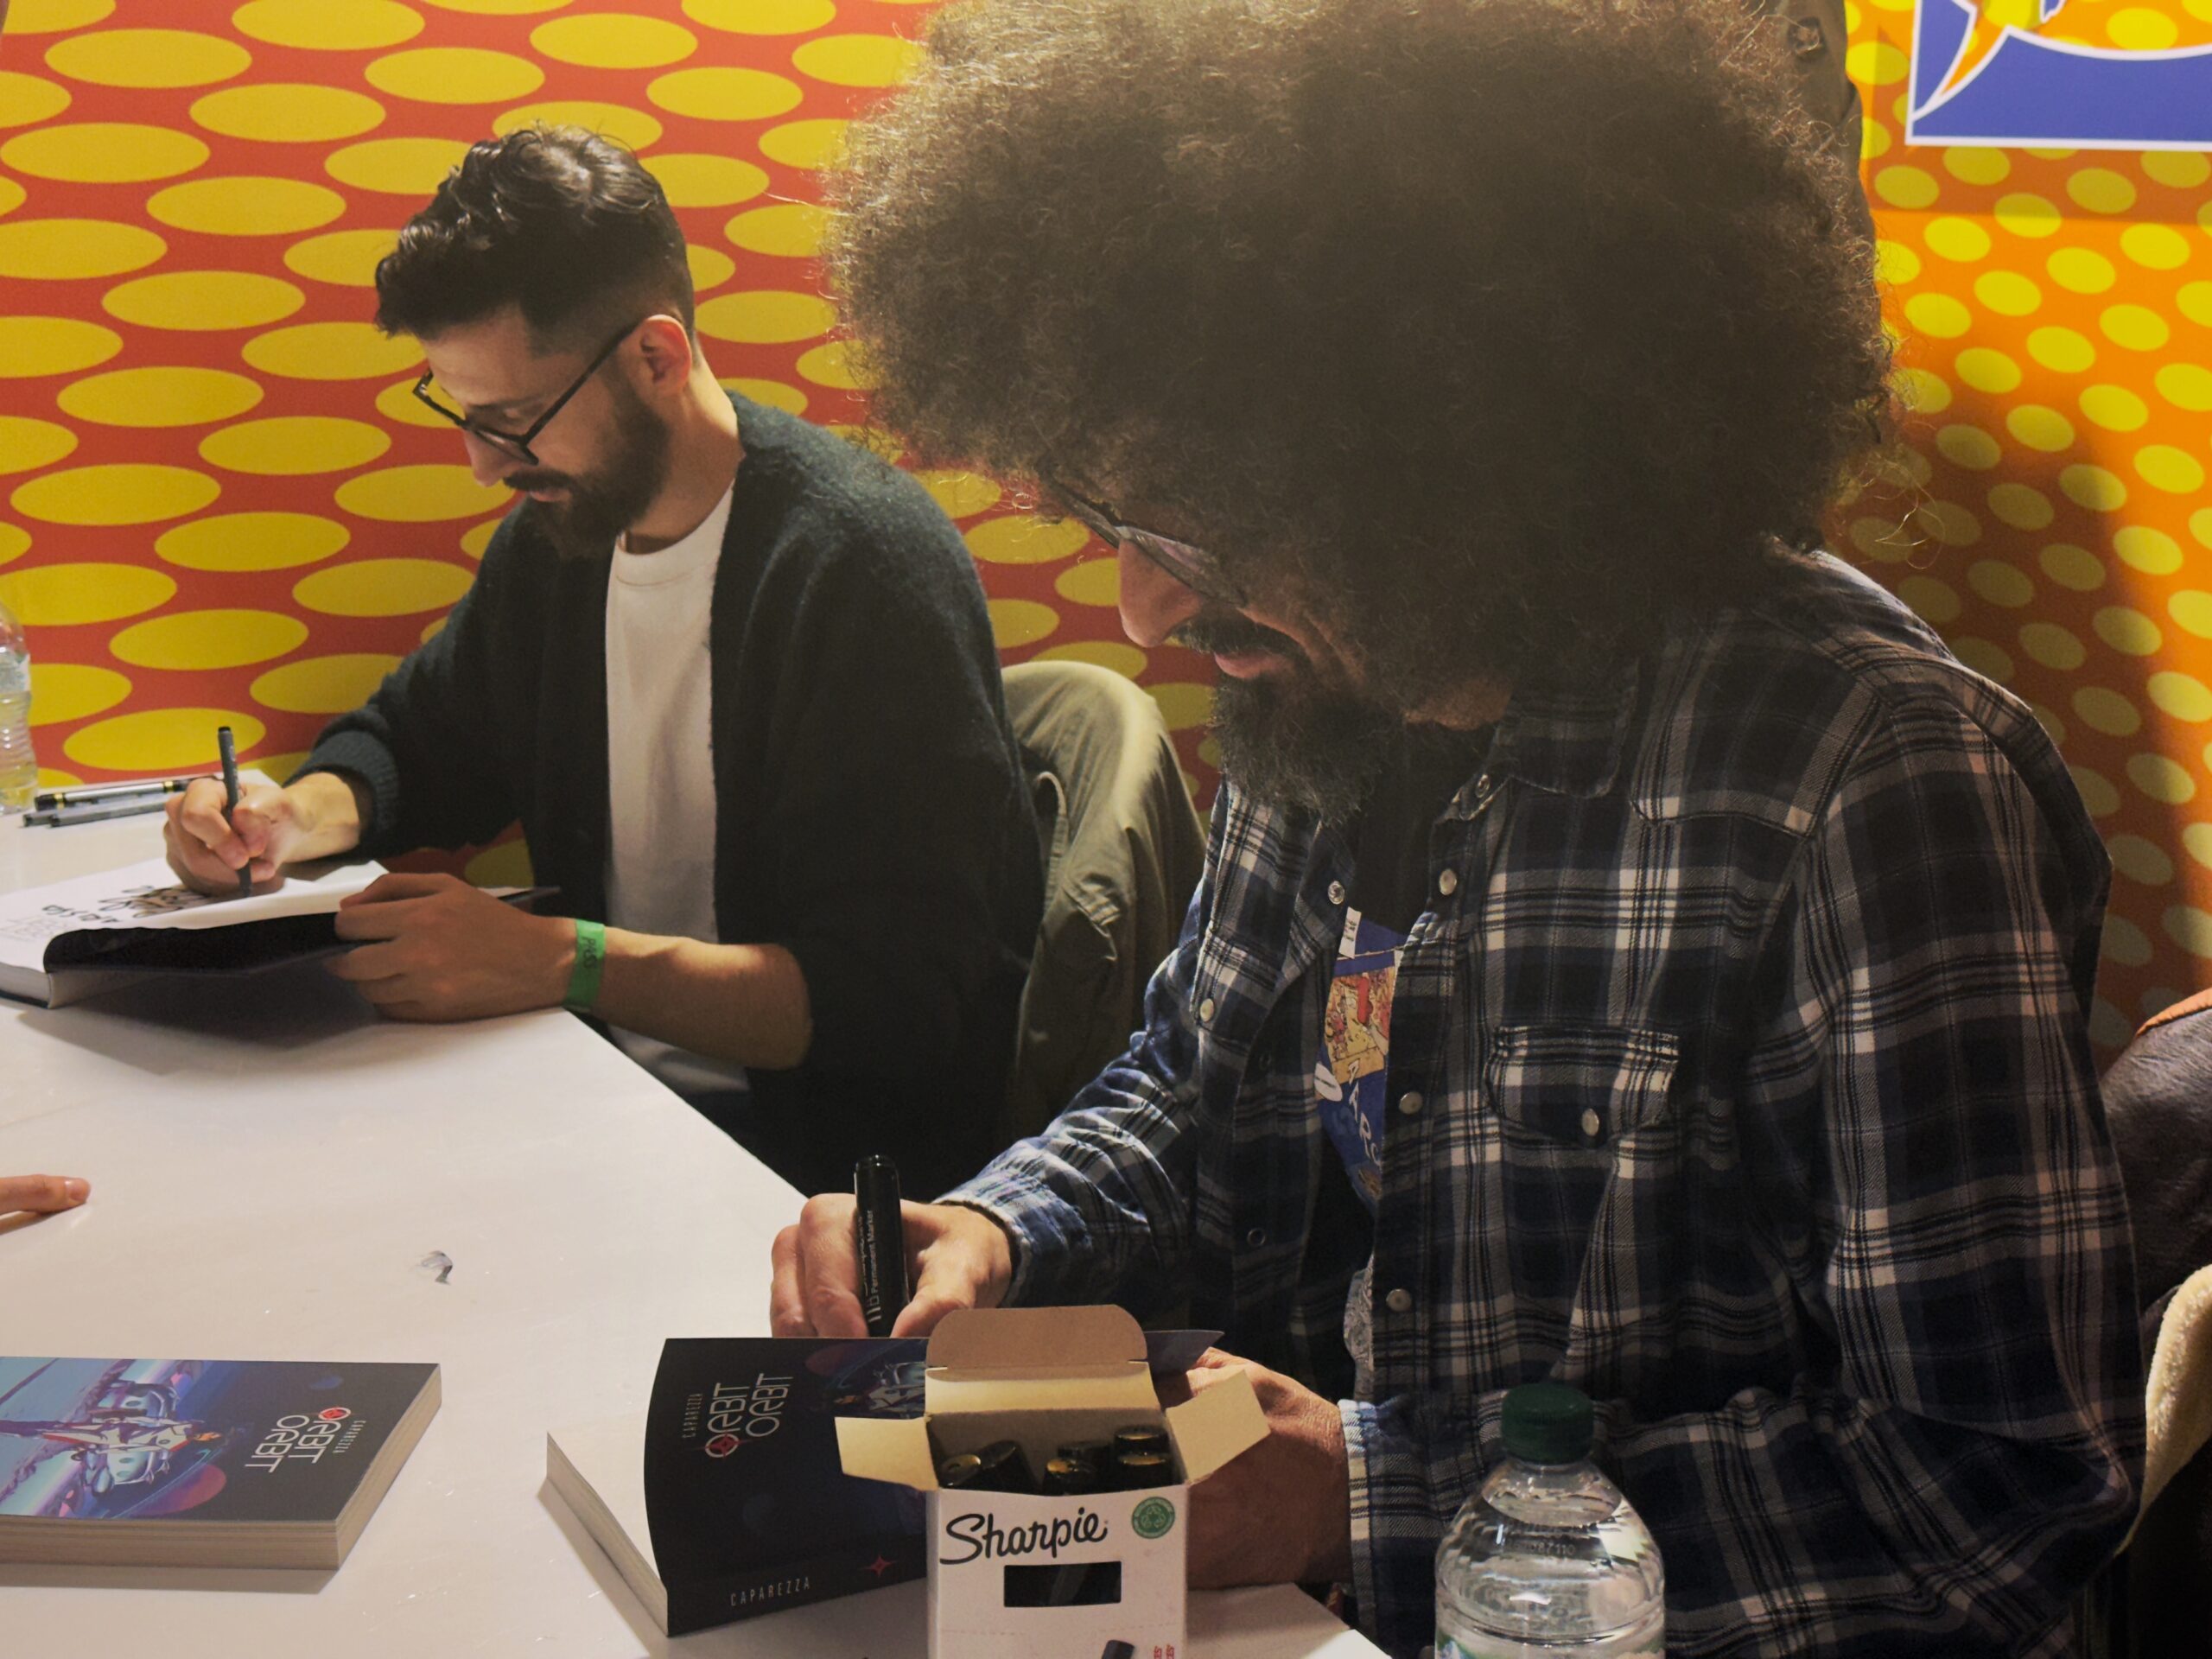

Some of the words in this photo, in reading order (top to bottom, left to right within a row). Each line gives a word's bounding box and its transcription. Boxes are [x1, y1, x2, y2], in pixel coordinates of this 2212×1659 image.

[745, 1372, 793, 1438] ORBIT
[245, 1414, 309, 1473] ORBIT
[939, 1507, 1109, 1565] Sharpie
[730, 1576, 811, 1606] CAPAREZZA
